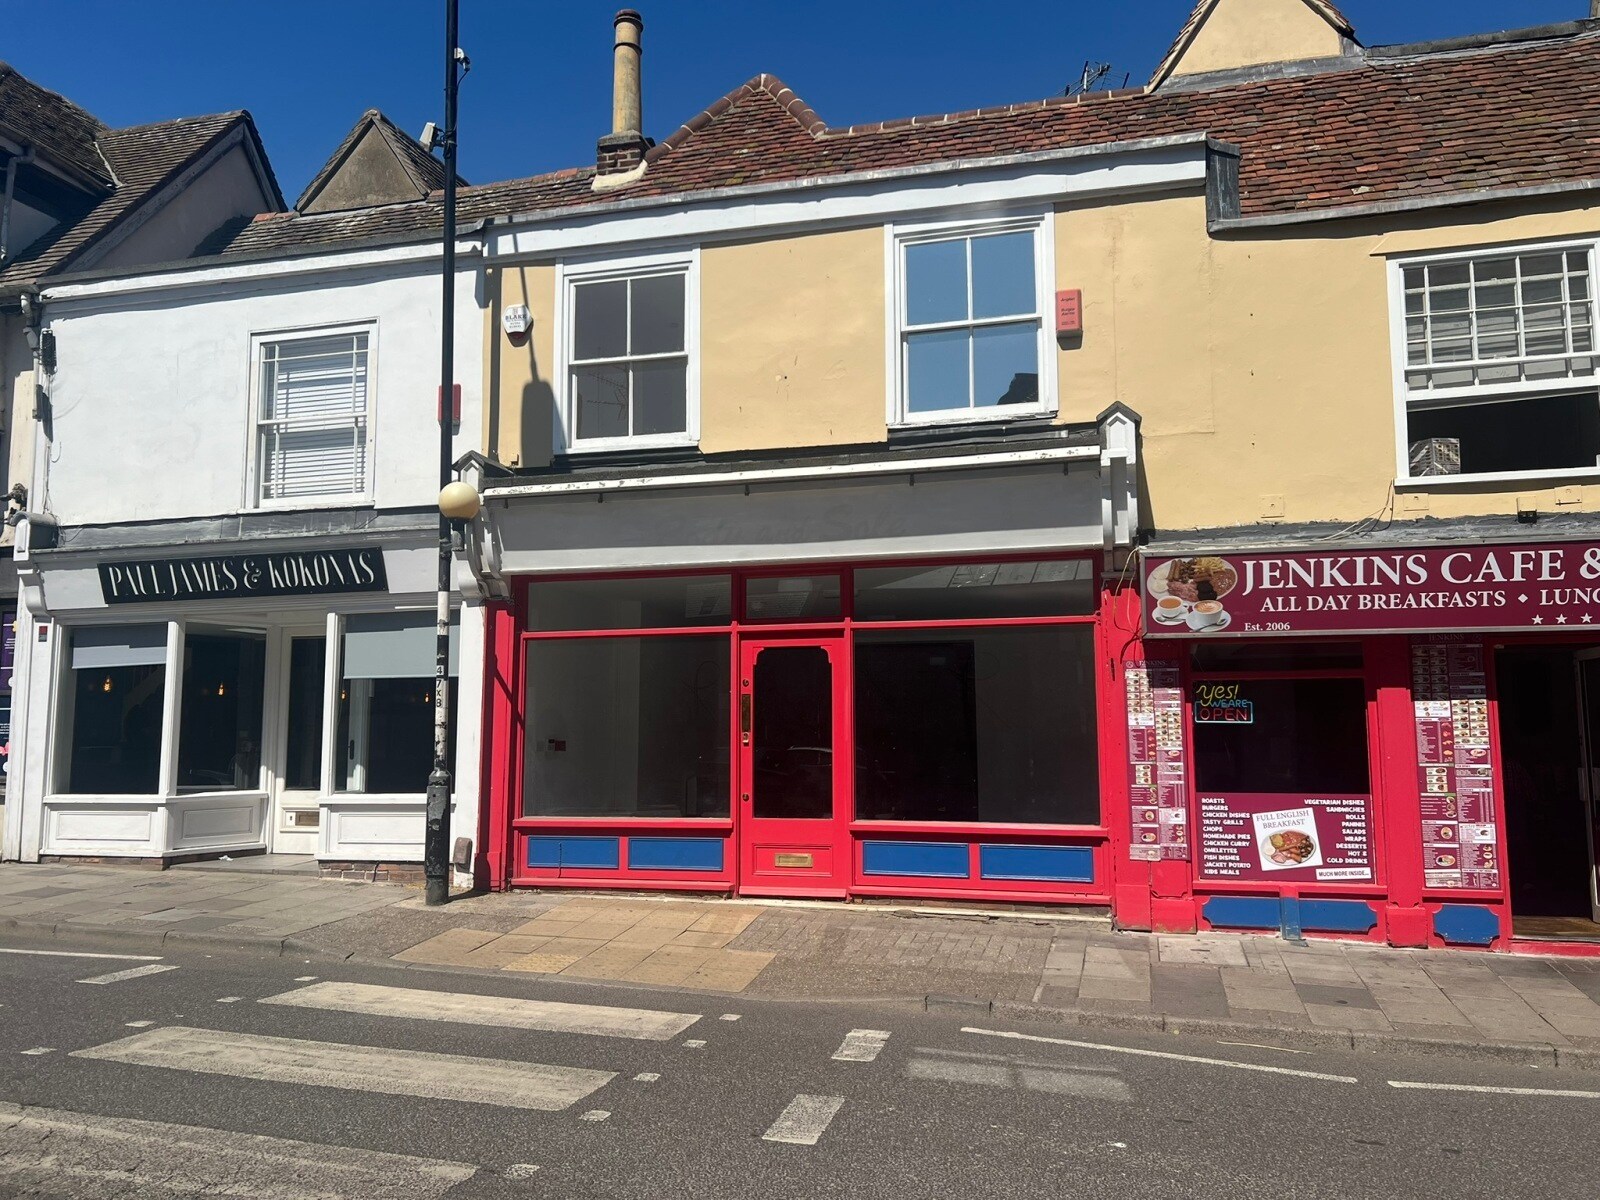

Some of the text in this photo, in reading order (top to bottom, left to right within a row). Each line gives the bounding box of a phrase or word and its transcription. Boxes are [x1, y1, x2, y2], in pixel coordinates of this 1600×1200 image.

[108, 552, 374, 596] PAUL JAMES & KOKONAS
[1242, 554, 1428, 596] JENKINS
[1440, 550, 1566, 584] CAFE
[1260, 596, 1302, 612] ALL
[1306, 594, 1352, 611] DAY
[1358, 590, 1506, 610] BREAKFASTS
[1244, 622, 1290, 631] Est. 2006
[1228, 700, 1248, 708] ARE
[1200, 708, 1247, 720] OPEN
[1276, 810, 1309, 819] ENGLISH
[1263, 819, 1305, 829] BREAKFAST
